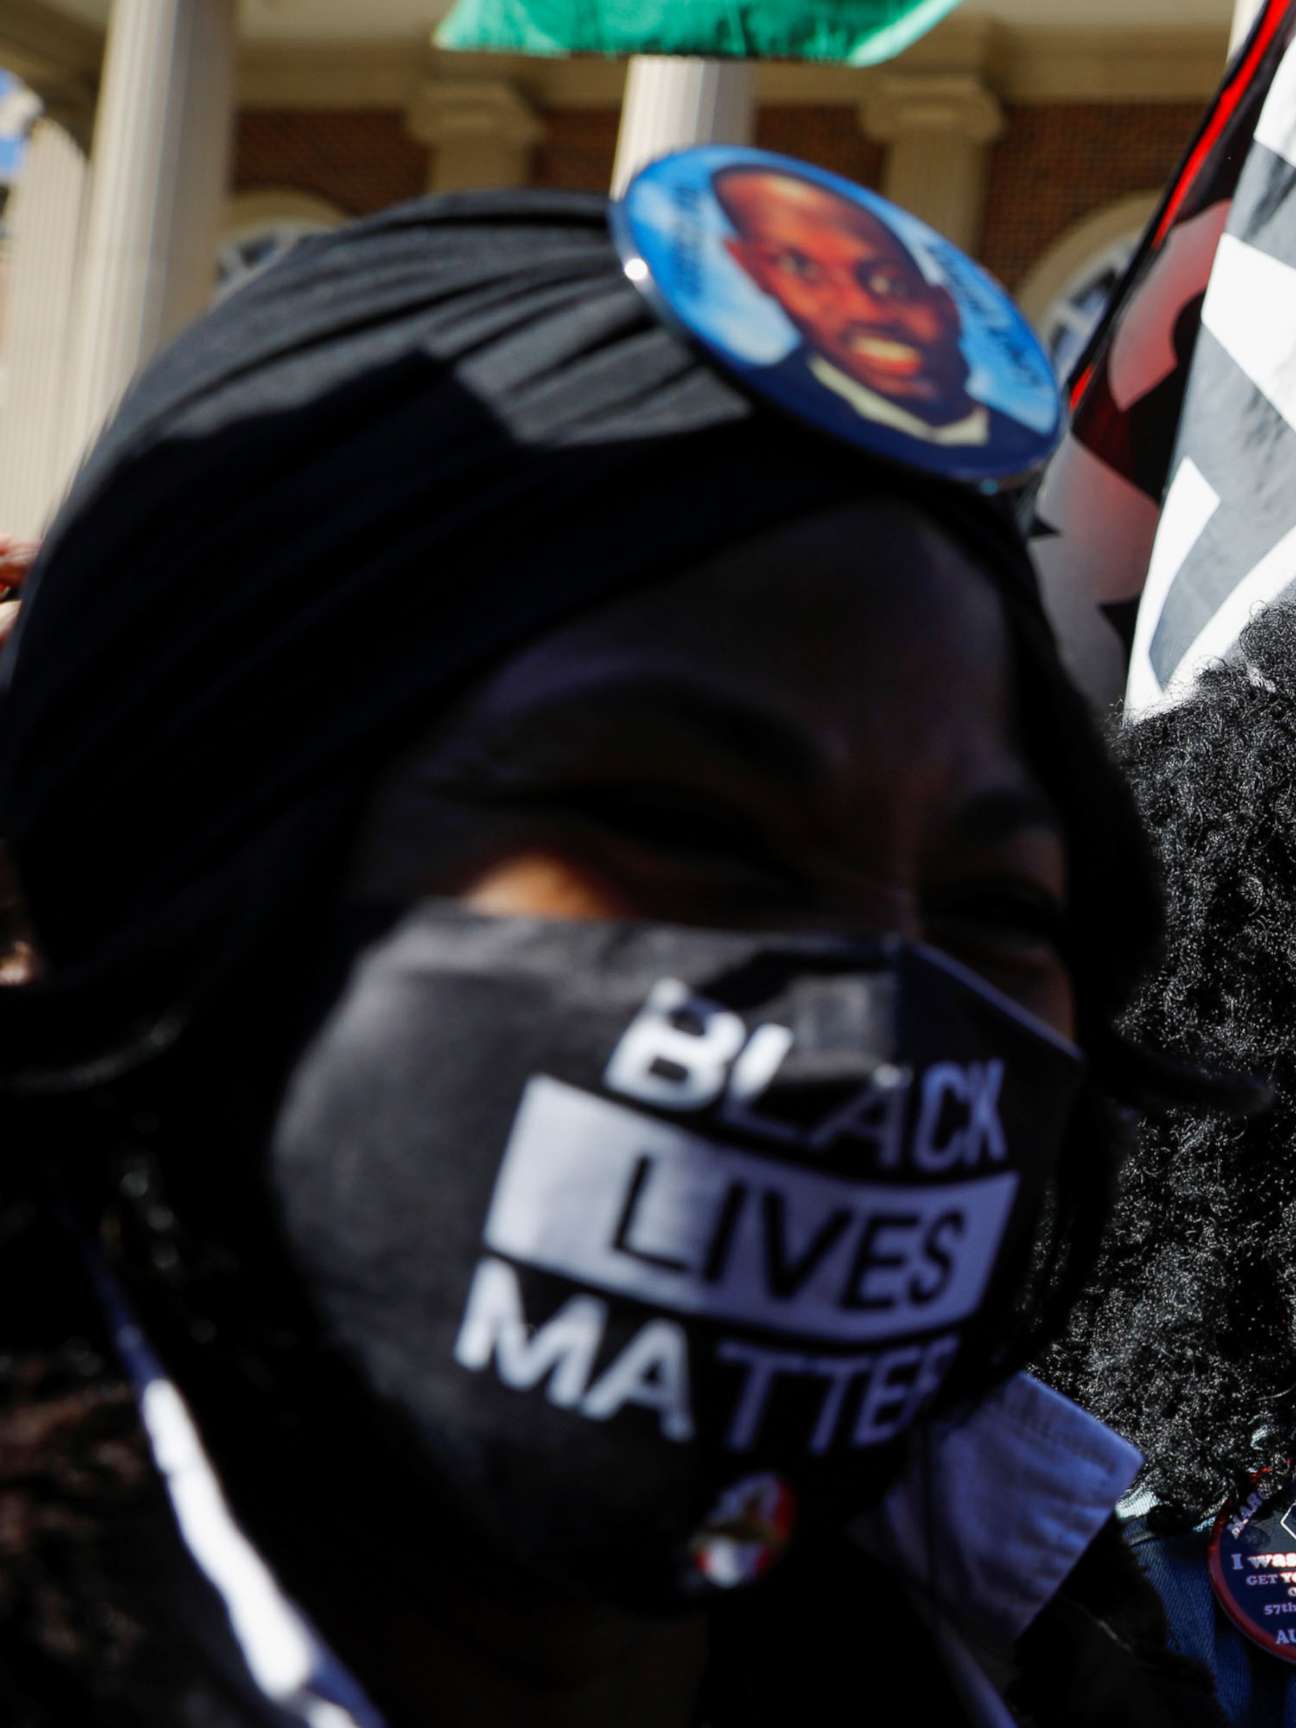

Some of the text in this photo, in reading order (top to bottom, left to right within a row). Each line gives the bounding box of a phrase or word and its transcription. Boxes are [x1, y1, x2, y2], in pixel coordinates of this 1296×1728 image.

[604, 976, 1008, 1172] BLACK
[610, 1153, 965, 1311] LIVES
[1231, 1553, 1243, 1570] I
[1246, 1573, 1278, 1586] GET
